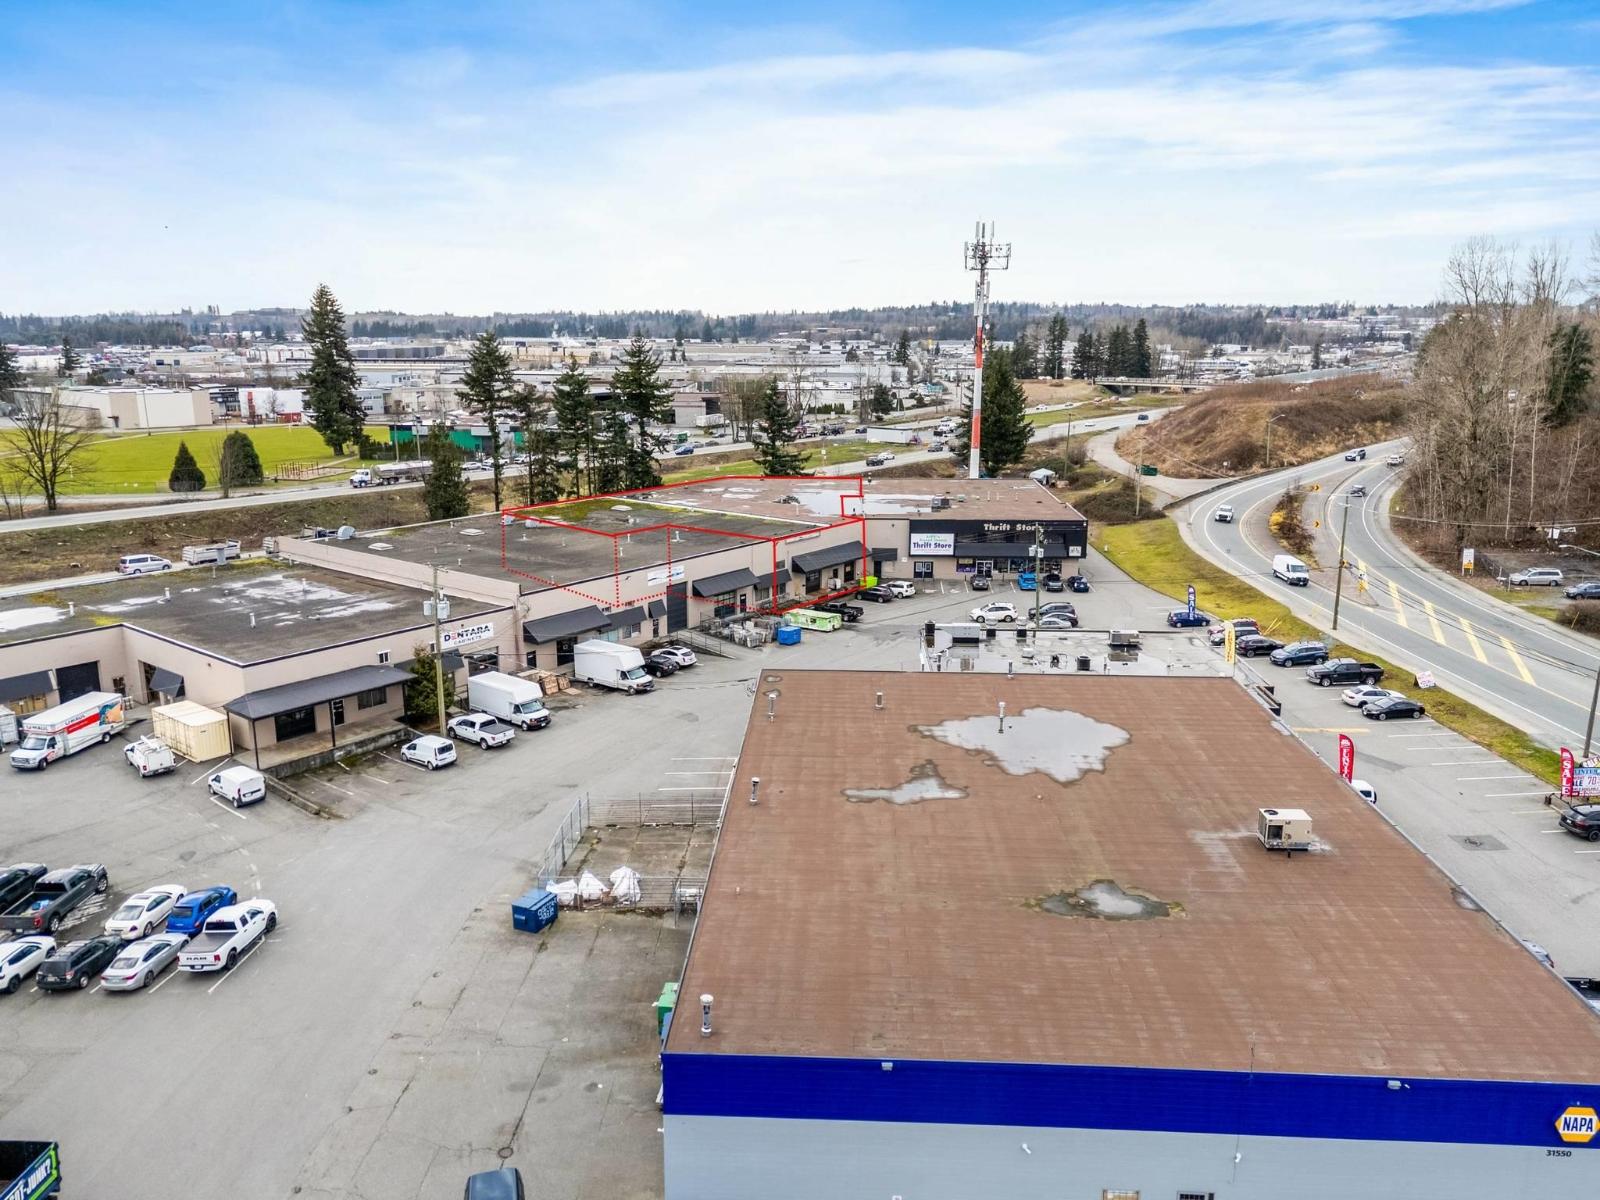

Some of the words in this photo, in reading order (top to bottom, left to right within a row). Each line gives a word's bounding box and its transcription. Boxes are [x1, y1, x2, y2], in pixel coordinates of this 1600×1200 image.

[1562, 760, 1572, 795] SALE
[1562, 1116, 1593, 1132] NAPA
[1545, 1149, 1572, 1157] 31550
